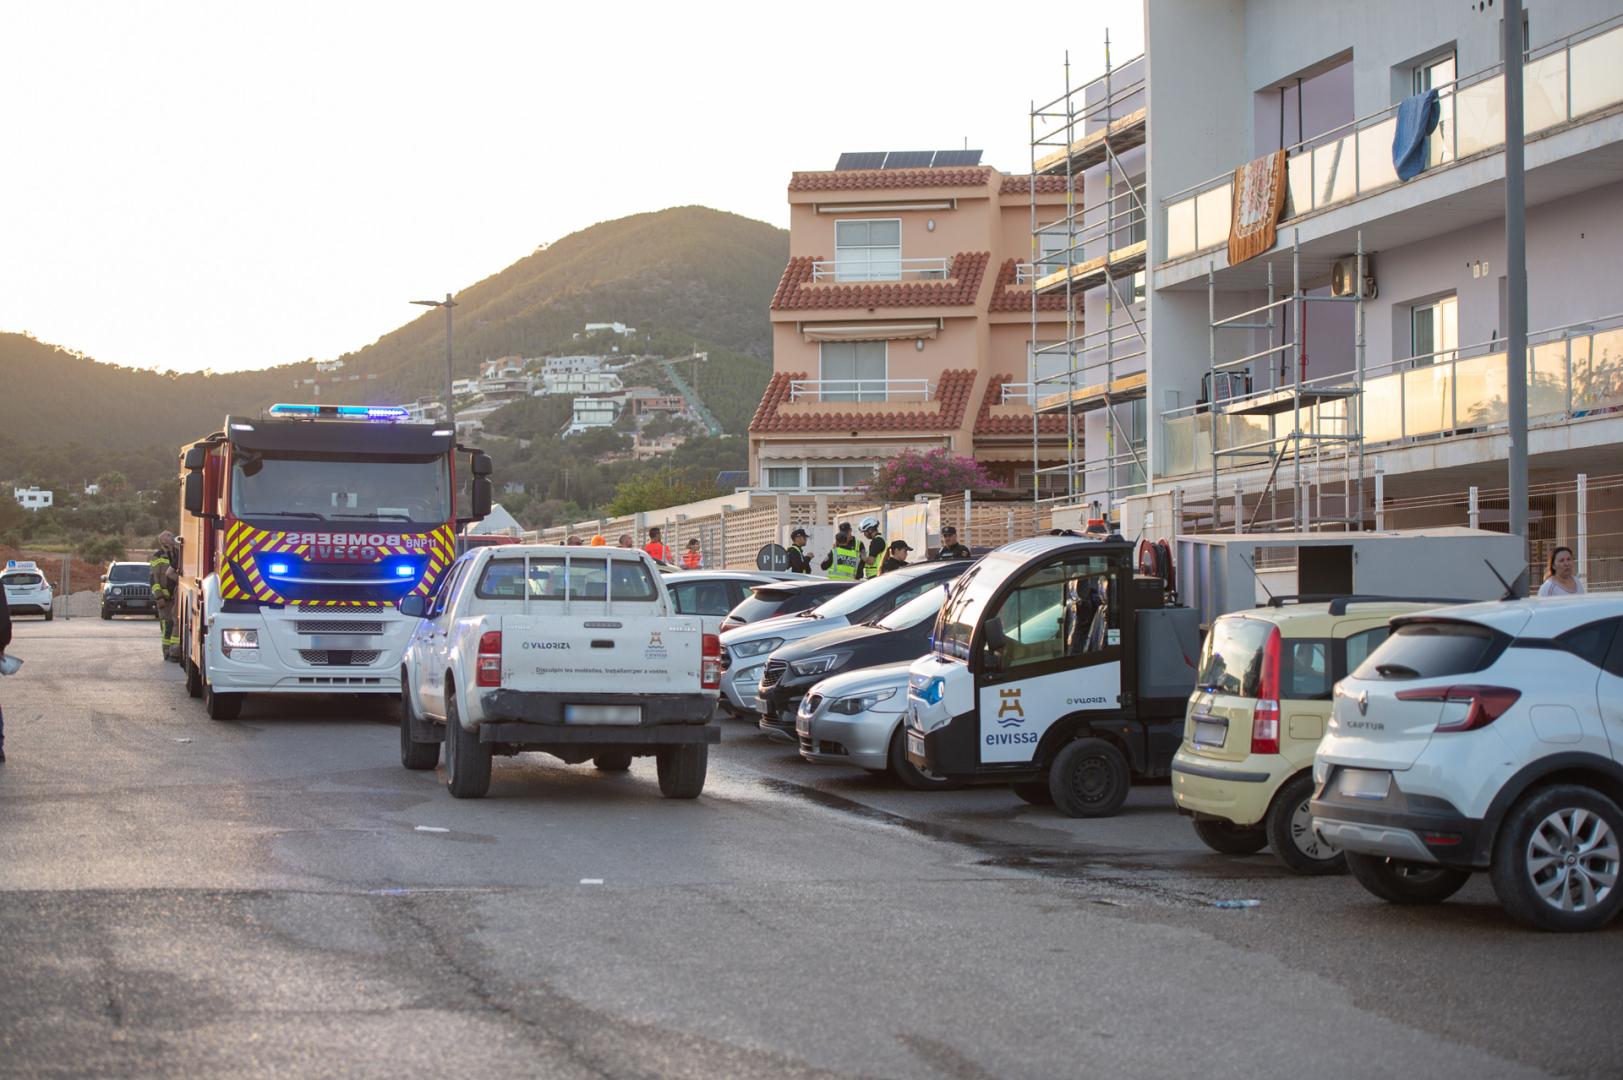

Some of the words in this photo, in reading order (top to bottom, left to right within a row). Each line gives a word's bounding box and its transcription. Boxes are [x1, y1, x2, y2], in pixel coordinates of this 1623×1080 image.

[406, 538, 437, 549] BNP11
[310, 546, 376, 559] IVECO
[1347, 721, 1384, 730] CAPTUR
